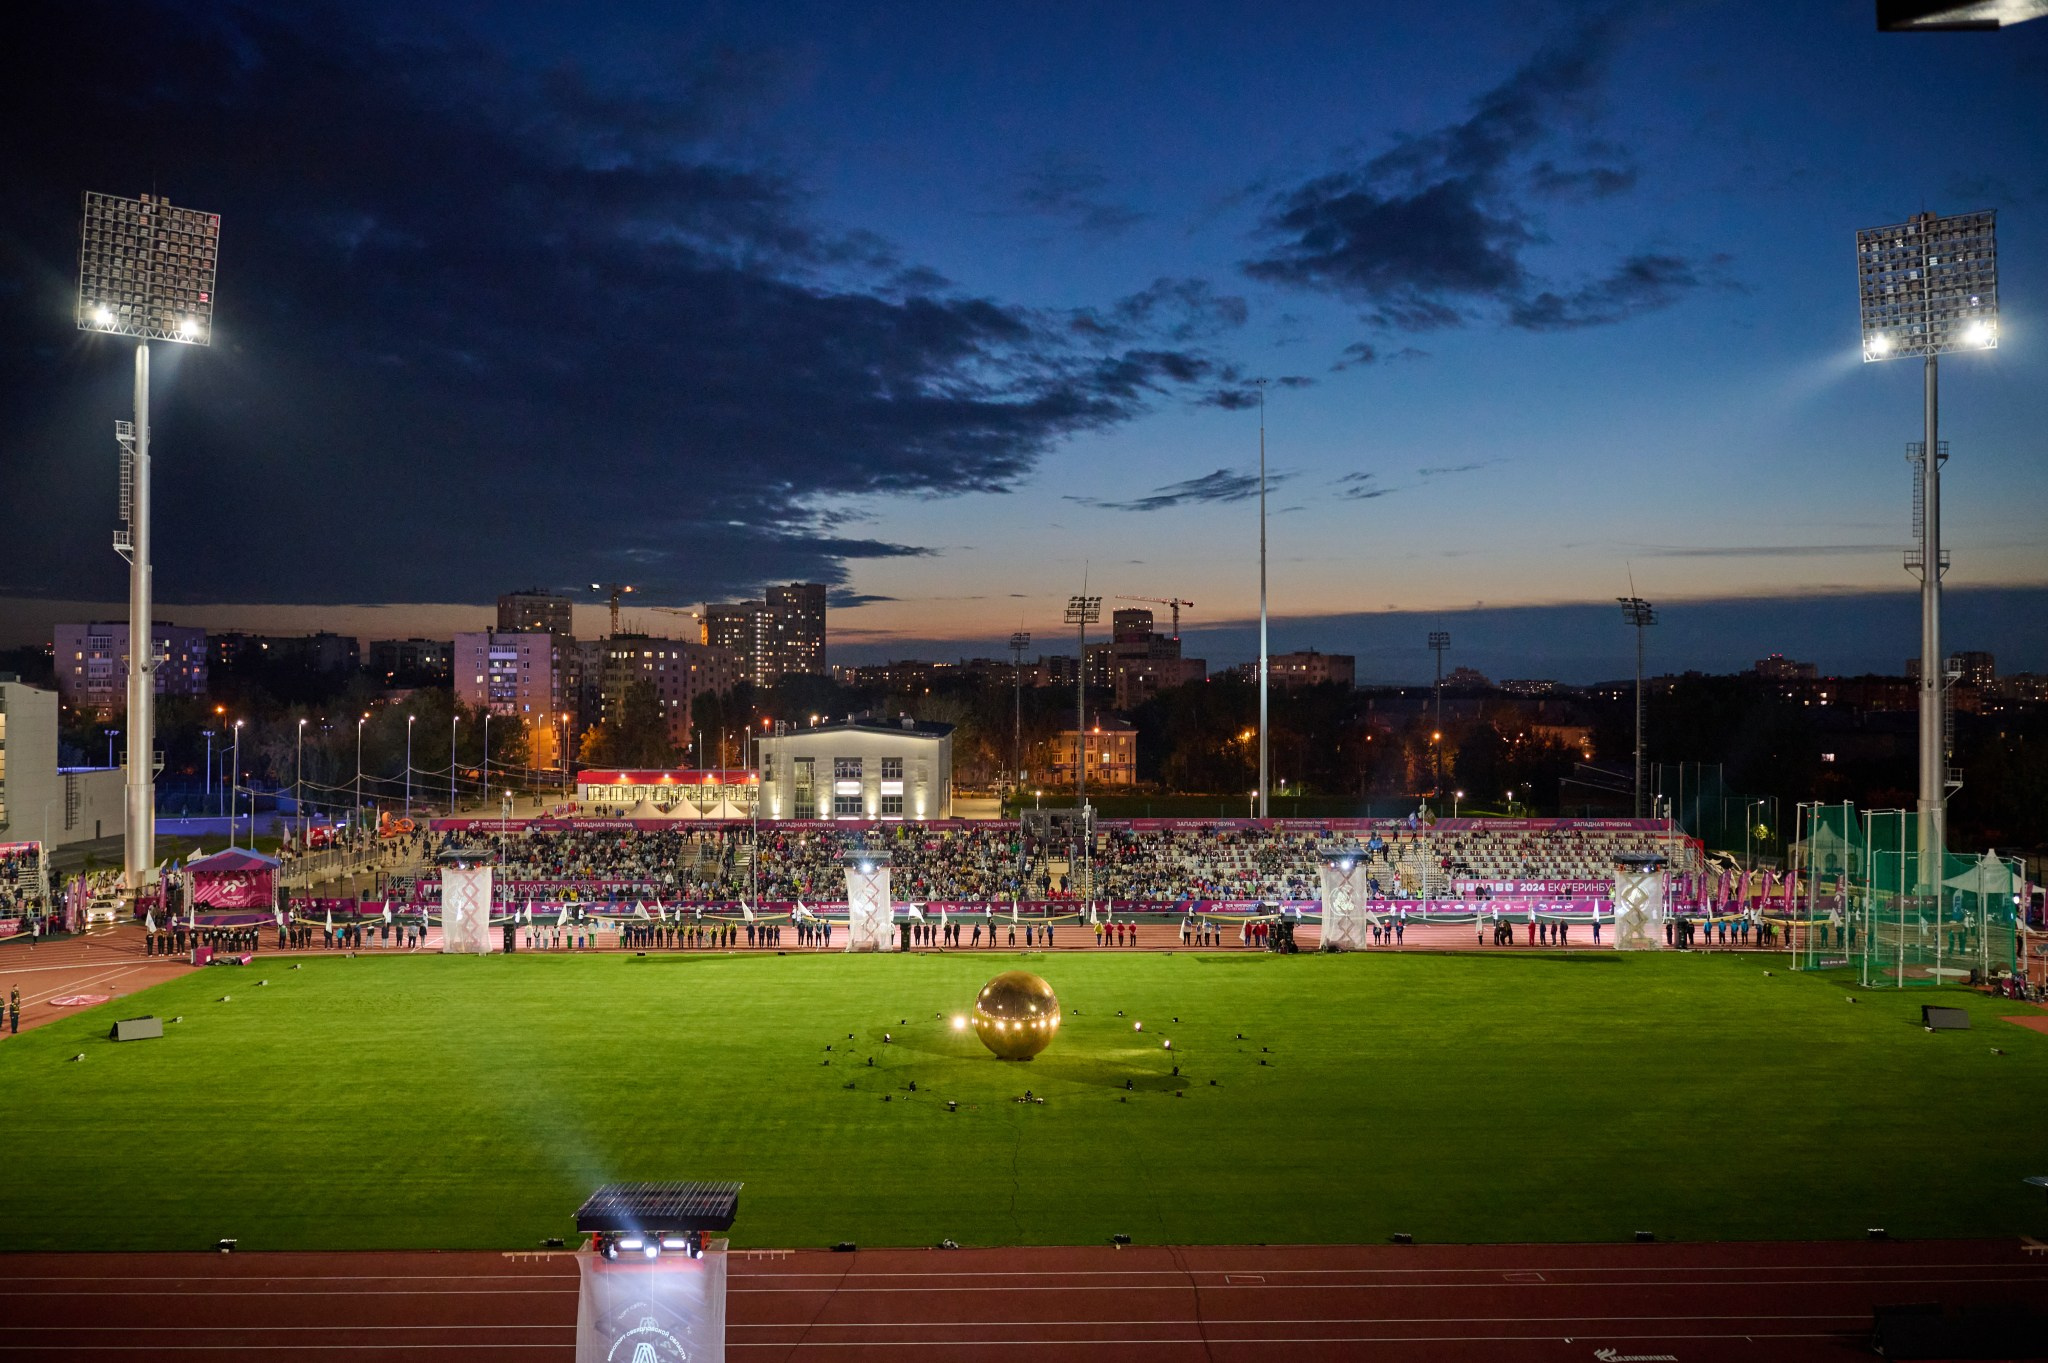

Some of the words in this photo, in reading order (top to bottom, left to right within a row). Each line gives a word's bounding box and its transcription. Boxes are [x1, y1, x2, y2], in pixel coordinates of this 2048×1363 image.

[608, 1334, 626, 1362] МИНСПОРТ
[626, 1326, 669, 1337] СВЕРДЛОВСКОЙ
[669, 1336, 686, 1360] ОБЛАСТИ
